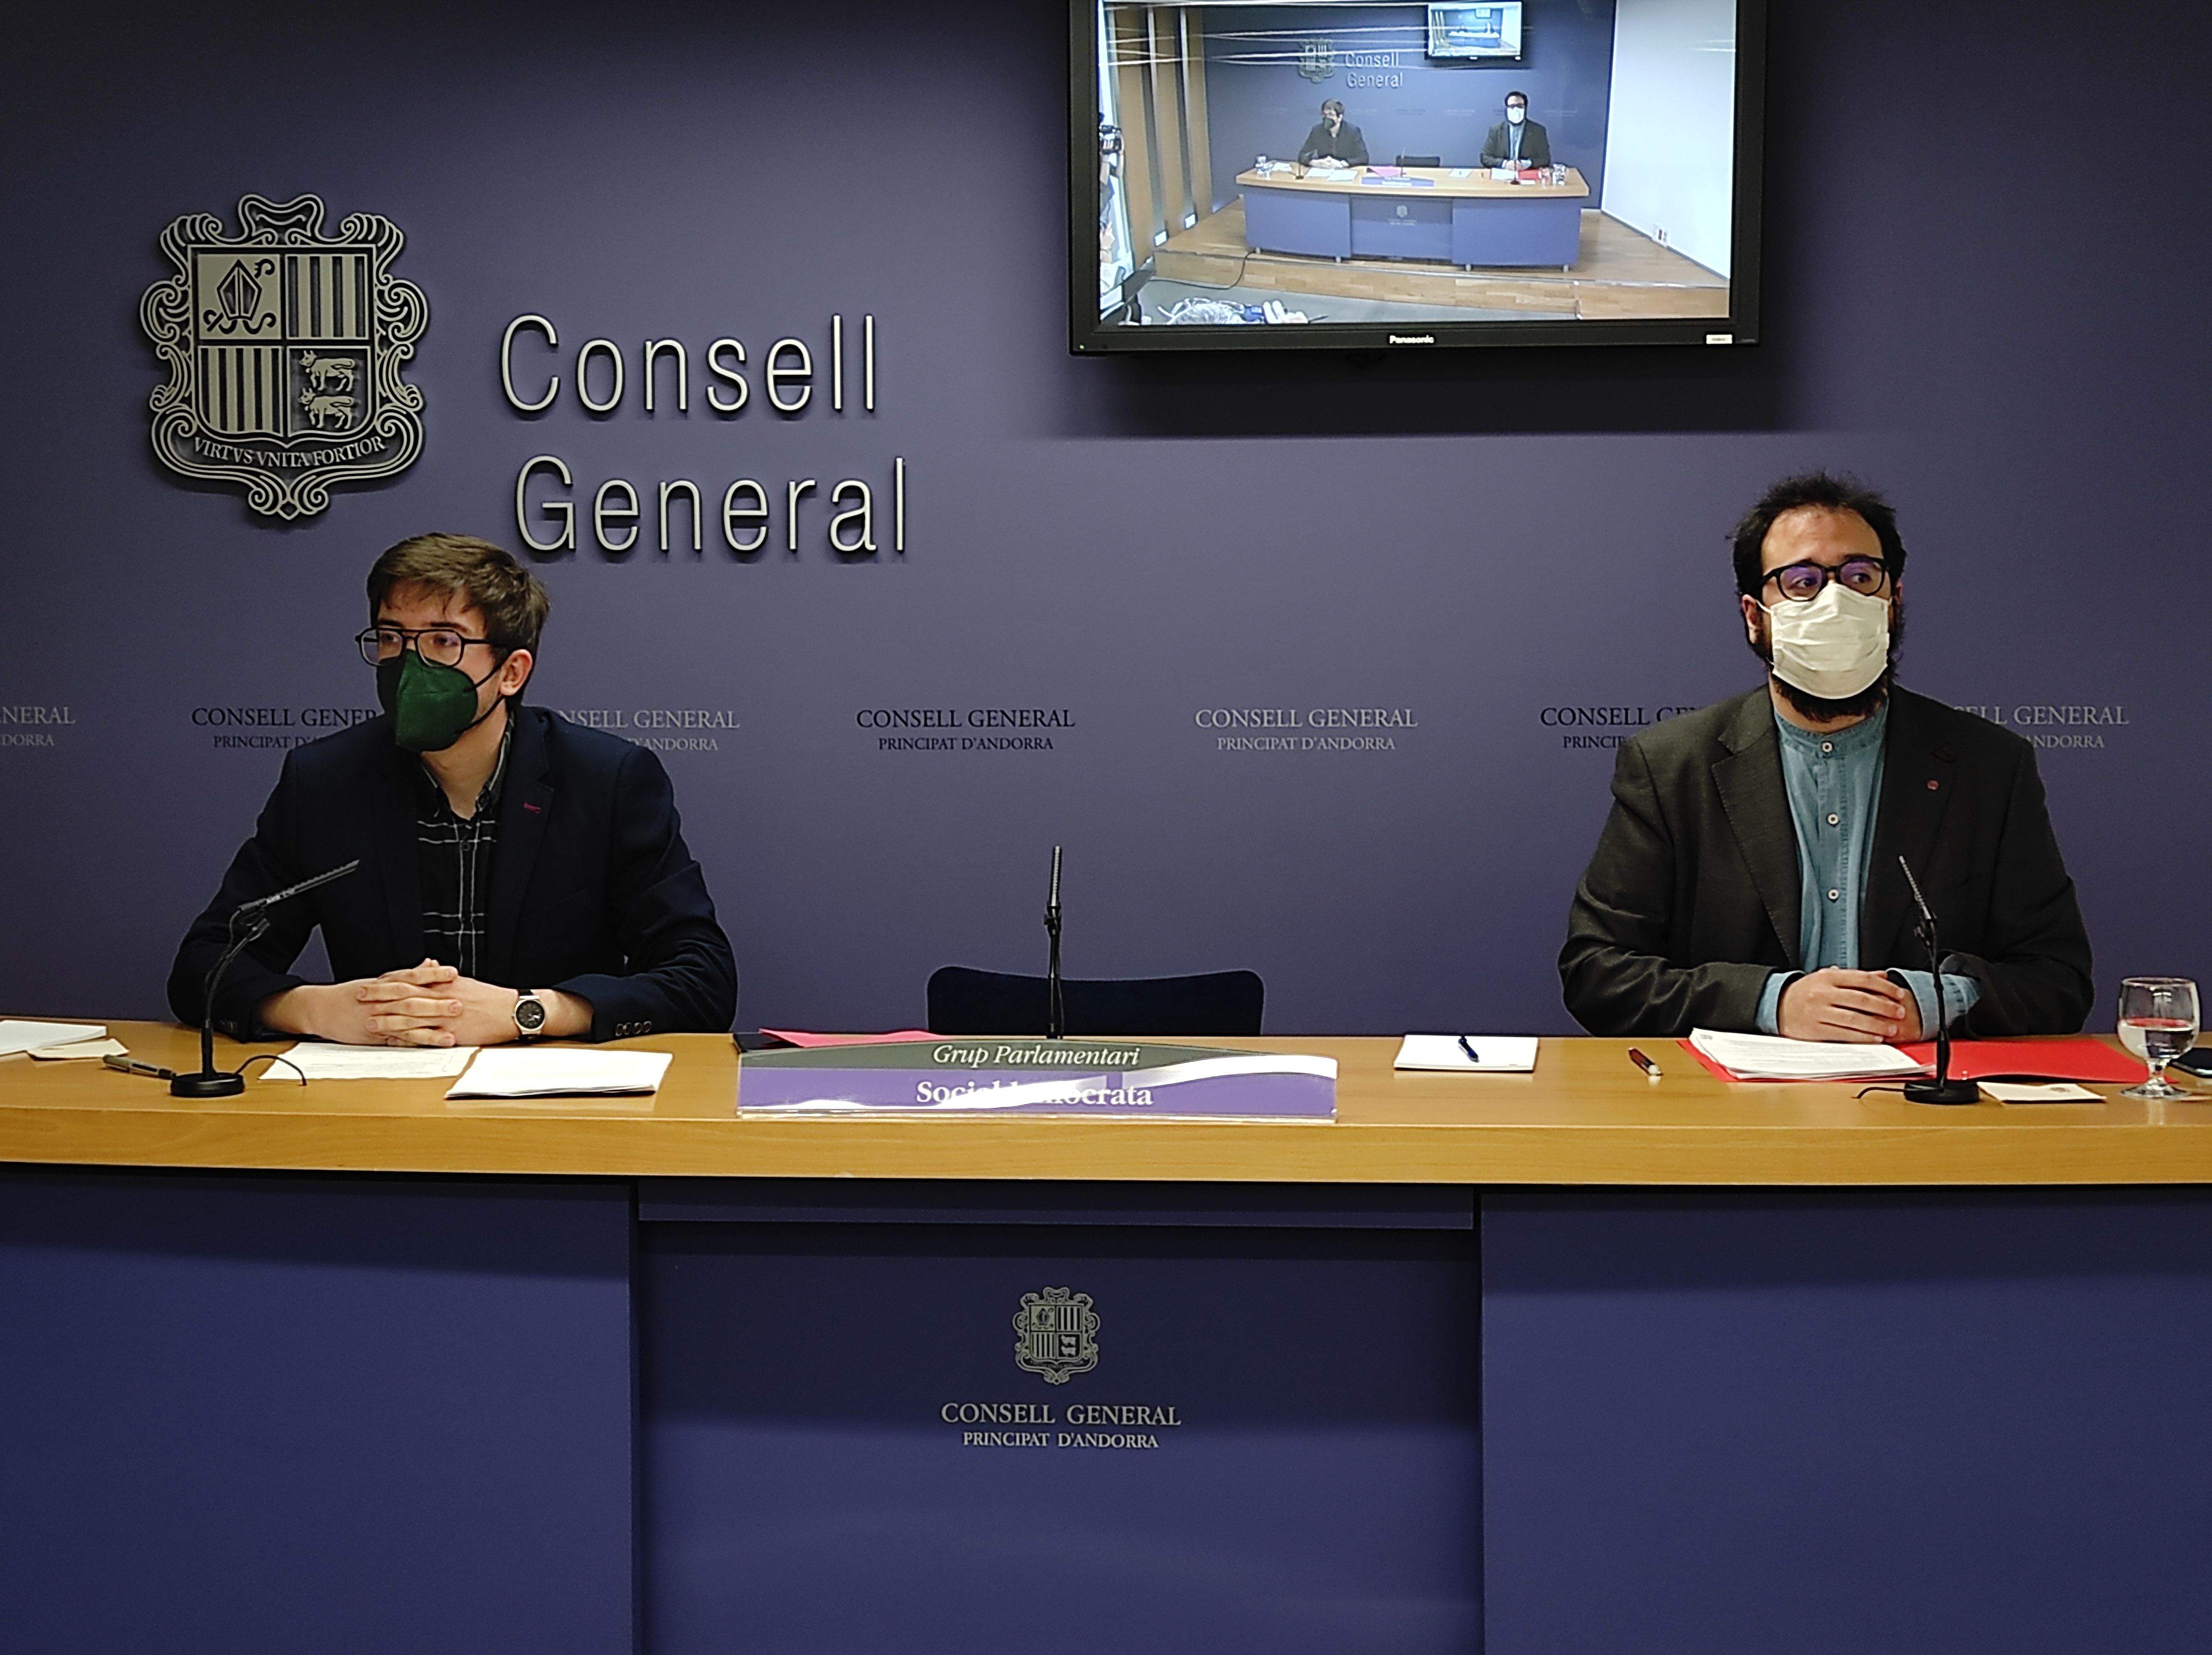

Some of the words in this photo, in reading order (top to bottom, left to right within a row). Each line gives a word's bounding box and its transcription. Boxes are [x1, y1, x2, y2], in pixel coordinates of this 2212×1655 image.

[1345, 51, 1399, 67] Consell
[1347, 71, 1403, 88] General
[500, 313, 876, 413] Consell
[312, 436, 387, 466] FORTIOR
[515, 454, 906, 553] General
[0, 706, 76, 724] NERAL
[192, 708, 296, 726] CONSELL
[557, 710, 628, 728] NSELL
[633, 710, 740, 728] GENERAL
[857, 709, 962, 727] CONSELL
[968, 709, 1075, 727] GENERAL
[1195, 709, 1303, 727] CONSELL
[1308, 709, 1418, 727] GENERAL
[1541, 707, 1650, 726] CONSELL
[2014, 705, 2129, 725] GENERAL
[2, 734, 55, 746] DORRA
[214, 736, 291, 748] PRINCIPAT
[879, 737, 958, 750] PRINCIPAT
[962, 737, 1053, 750] D'ANDORRA
[1218, 737, 1298, 750] PRINCIPAT
[1302, 737, 1395, 750] D'ANDORRA
[1563, 736, 1625, 748] PRINCI
[2027, 735, 2104, 748] NDORRA
[933, 1044, 989, 1068] Grup
[993, 1045, 1140, 1065] Parlamentari
[941, 1403, 1055, 1424] CONSELL
[1066, 1405, 1181, 1426] GENERAL
[963, 1432, 1050, 1447] PRINCIPAT
[1058, 1433, 1159, 1448] D'ANDORRA
